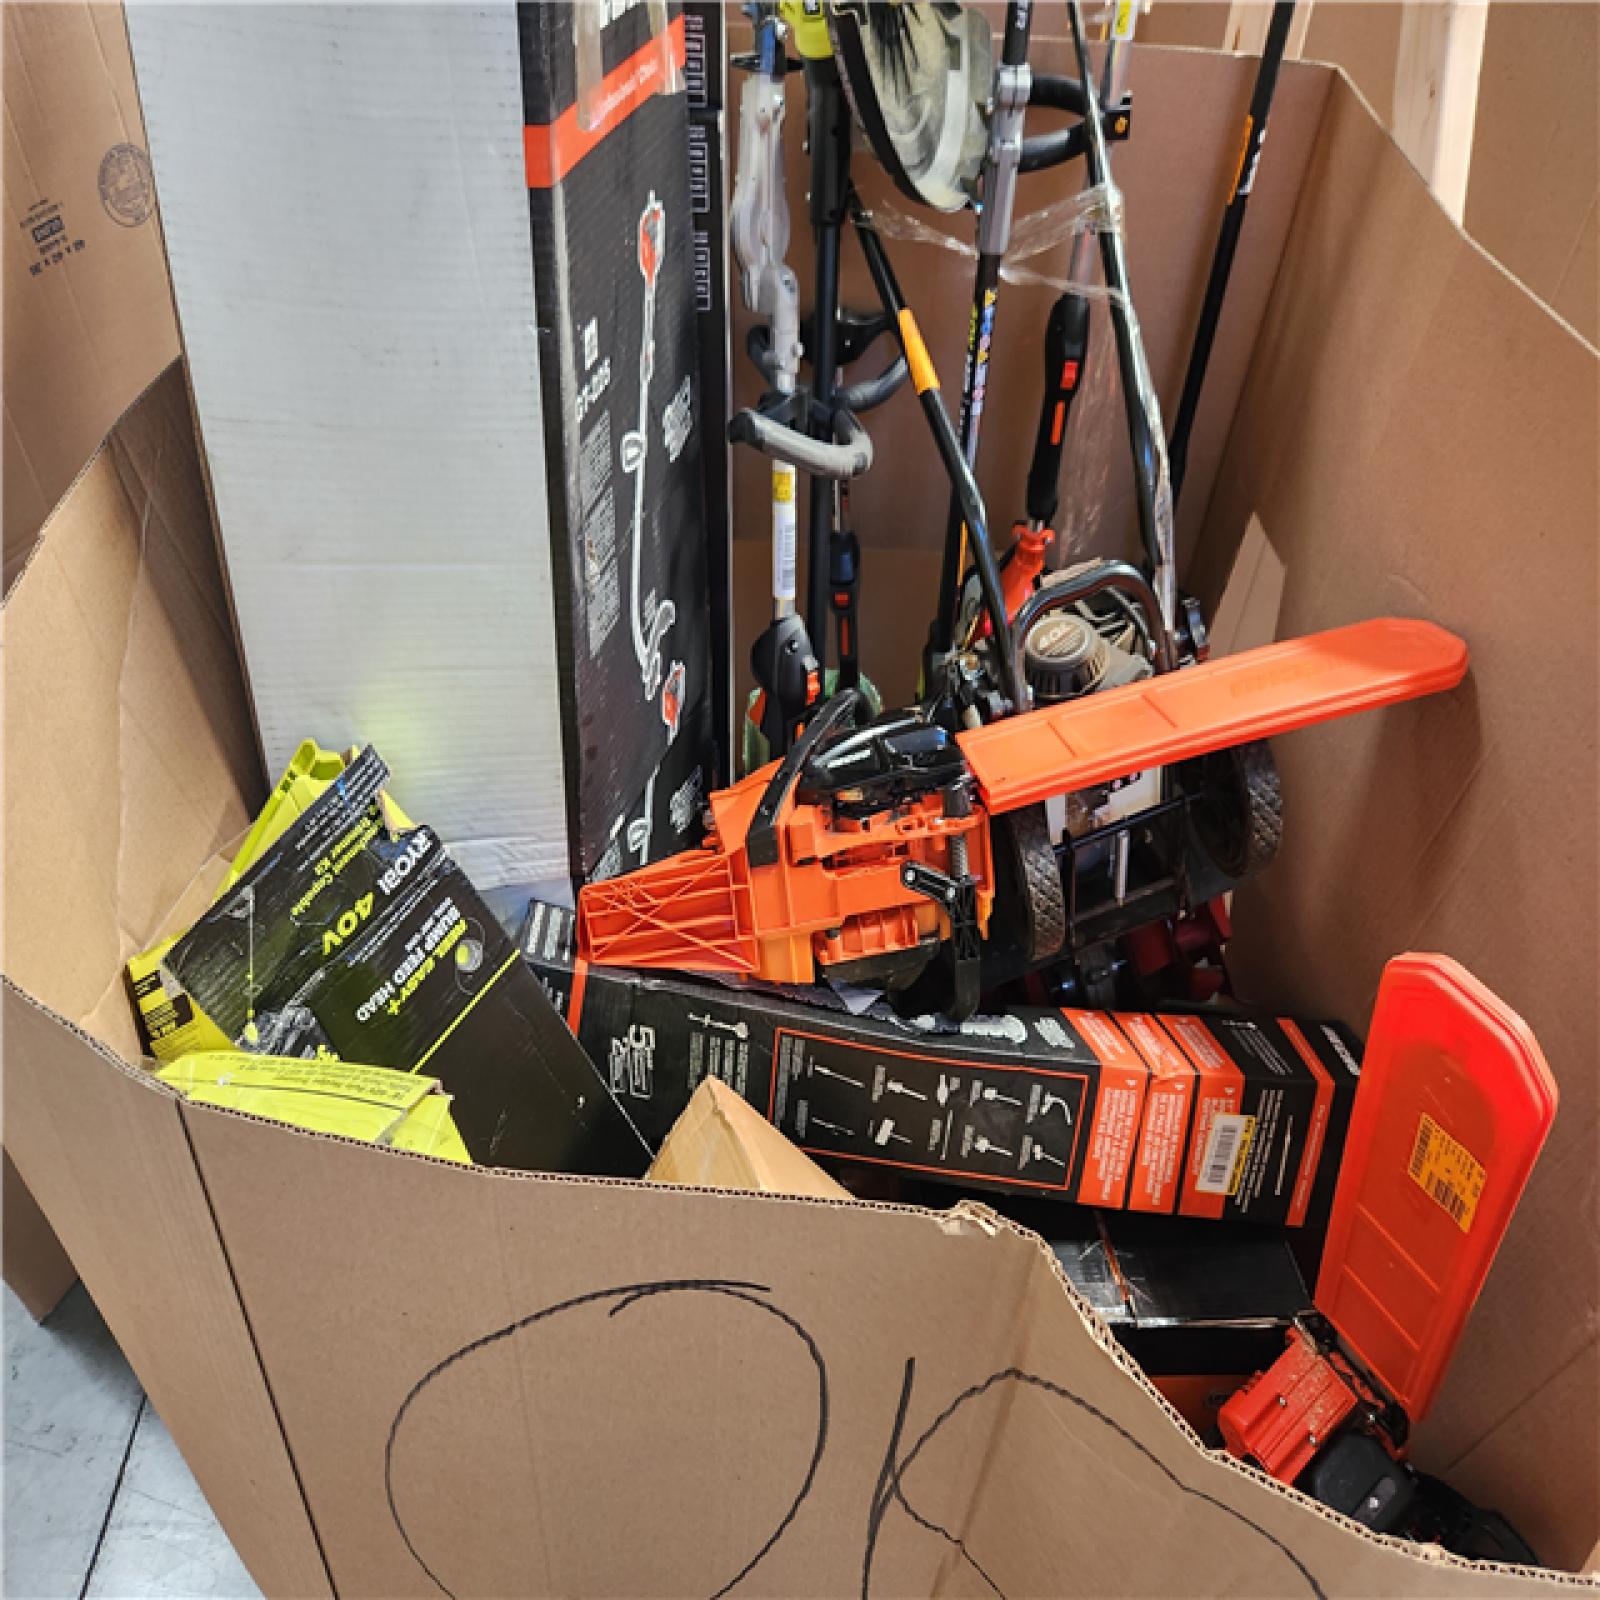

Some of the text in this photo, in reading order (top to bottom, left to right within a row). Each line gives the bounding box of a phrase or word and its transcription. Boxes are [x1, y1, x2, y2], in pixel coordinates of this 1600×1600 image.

[313, 830, 435, 959] RYOBI 40V
[352, 904, 463, 1024] BUMP FEED HEAD
